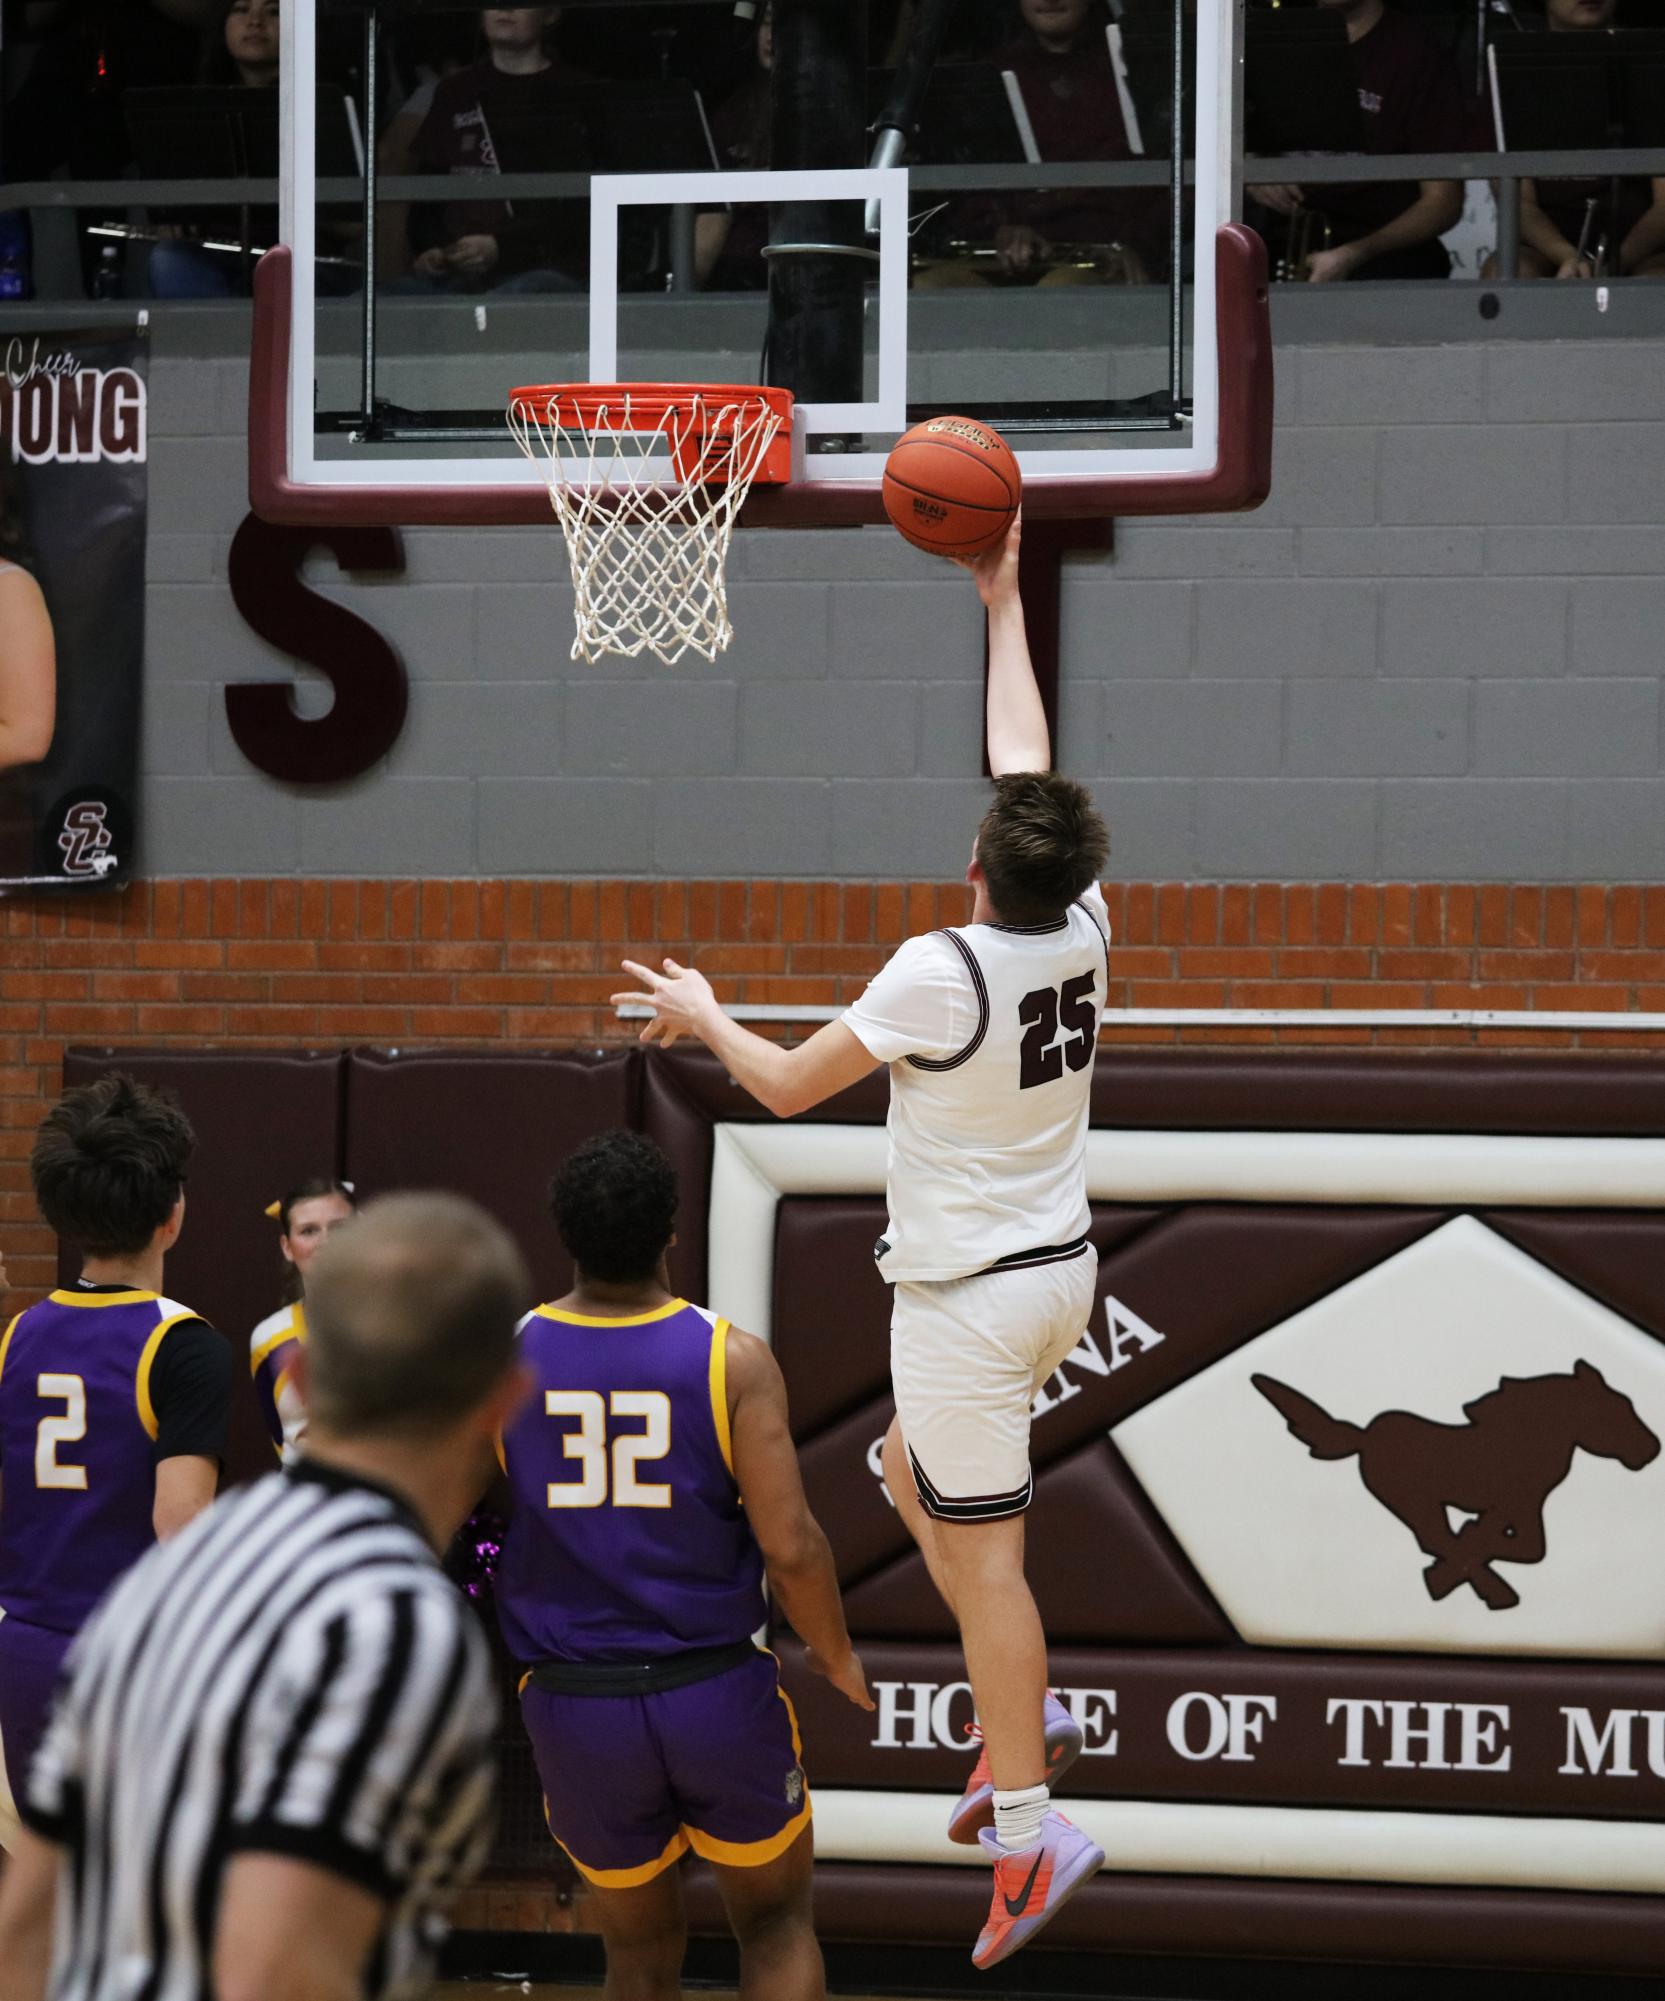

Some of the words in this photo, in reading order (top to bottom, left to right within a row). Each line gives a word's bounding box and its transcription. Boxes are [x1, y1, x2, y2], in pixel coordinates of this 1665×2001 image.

[6, 337, 82, 390] Cheer
[1018, 968, 1096, 1090] 25
[35, 1373, 88, 1489] 2
[545, 1390, 672, 1508] 32
[871, 1681, 1118, 1756] HOE
[1166, 1691, 1277, 1762] OF
[1326, 1698, 1512, 1772] THE
